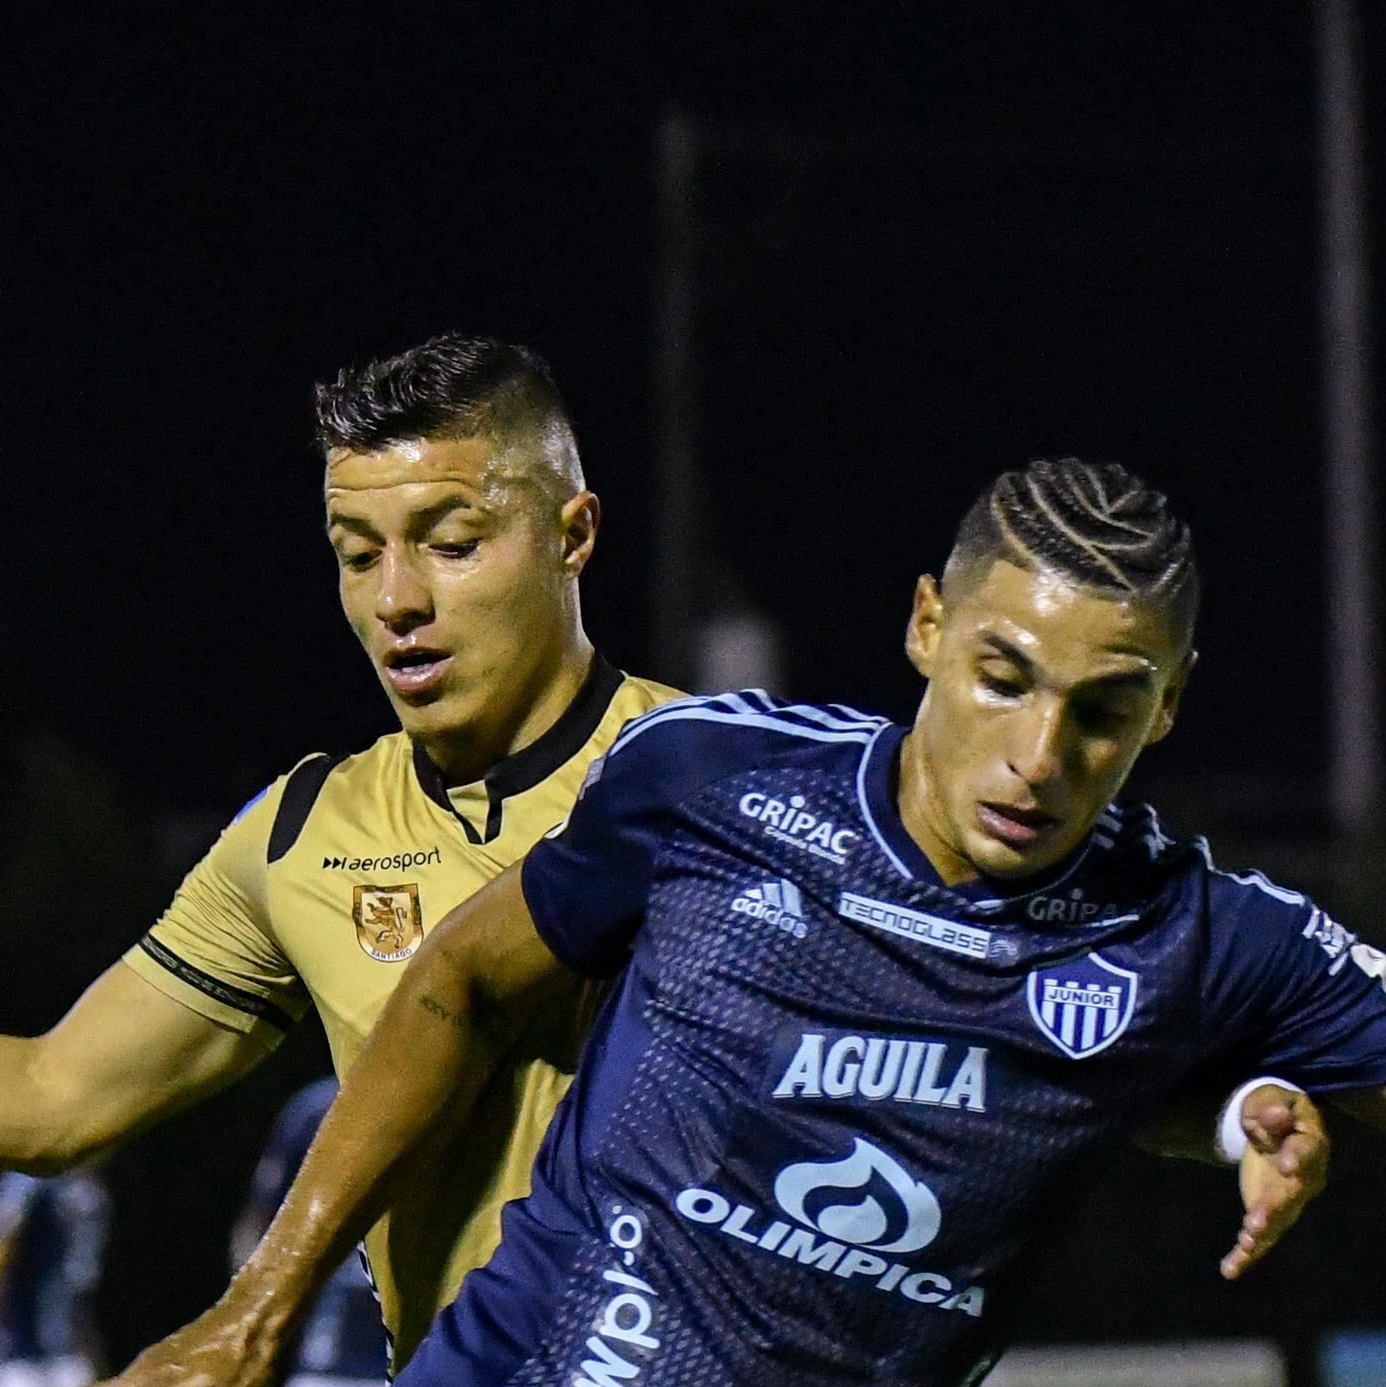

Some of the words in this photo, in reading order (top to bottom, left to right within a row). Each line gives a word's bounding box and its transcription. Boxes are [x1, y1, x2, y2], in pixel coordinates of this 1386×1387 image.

[739, 792, 855, 855] GRIPAC
[349, 846, 442, 872] aerosport
[731, 897, 808, 940] adidas
[843, 898, 987, 953] TECNOGLASS
[1028, 888, 1119, 921] GRIP
[370, 947, 413, 960] SANTIAGO
[1048, 988, 1116, 1006] JUNIOR
[772, 1033, 989, 1112] AGUILA
[676, 1187, 986, 1317] OLIMPICA
